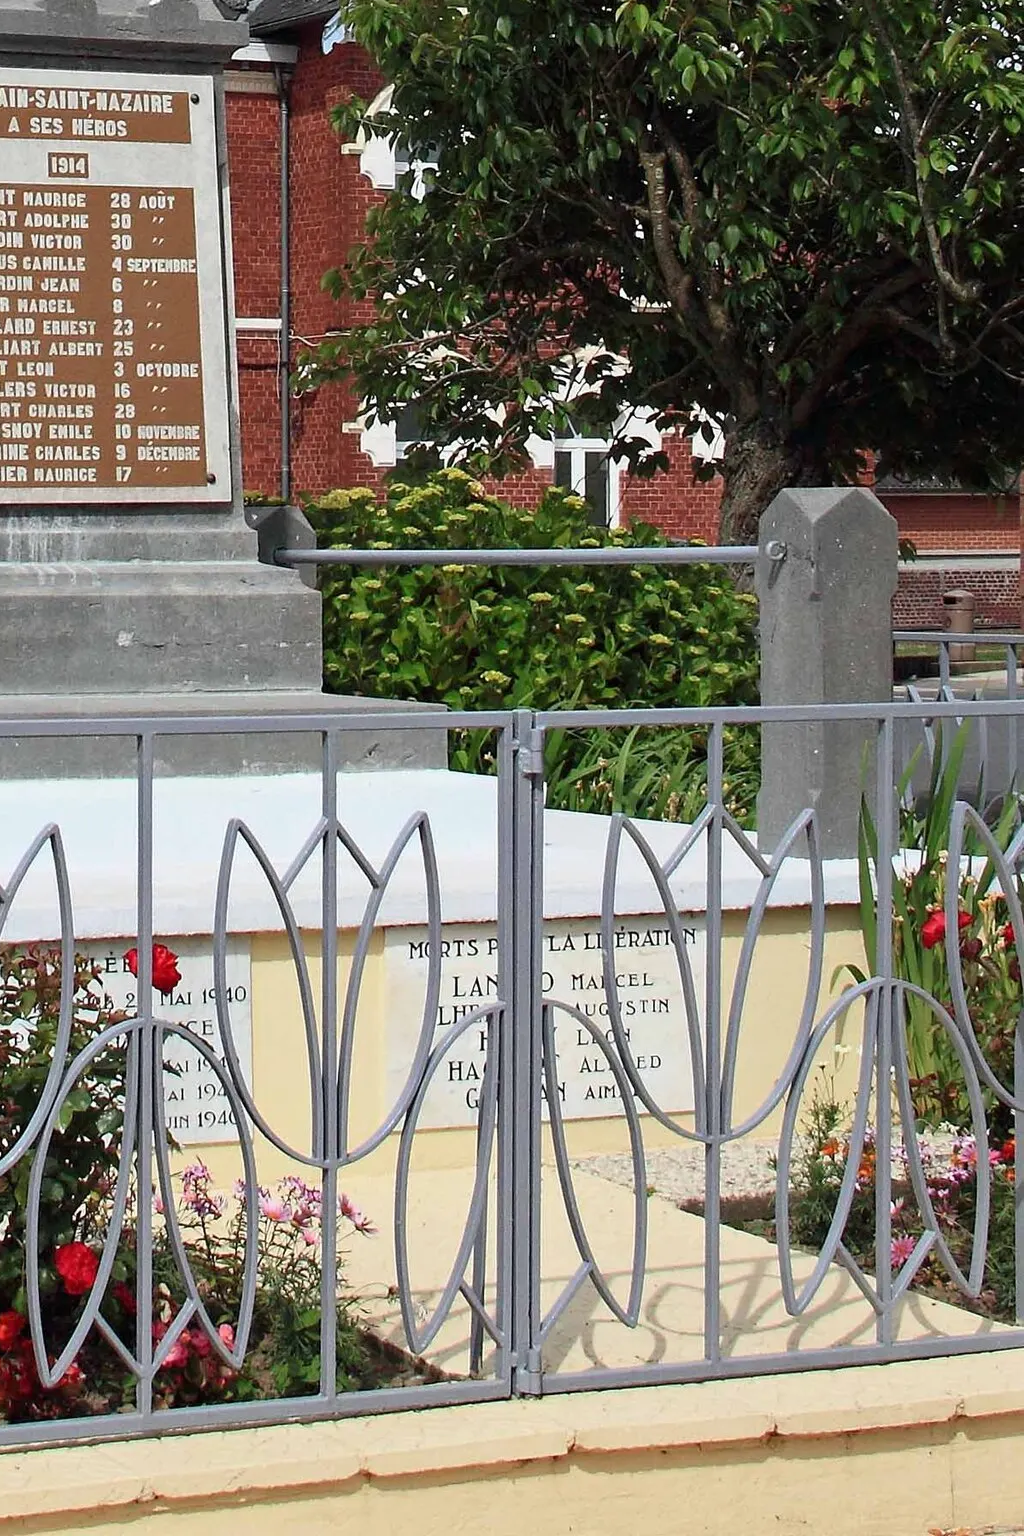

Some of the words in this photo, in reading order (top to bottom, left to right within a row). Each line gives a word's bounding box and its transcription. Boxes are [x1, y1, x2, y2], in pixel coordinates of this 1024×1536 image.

[8, 117, 20, 132] A
[30, 118, 62, 134] SES
[72, 114, 128, 136] HÉROS
[51, 157, 86, 174] 1914
[24, 192, 86, 208] MAURICE
[110, 193, 130, 208] 28
[138, 191, 174, 210] AOÛT
[24, 214, 88, 229] ADOLPHE
[112, 214, 131, 229] 30
[31, 234, 82, 249] VICTOR
[112, 234, 132, 250] 30
[23, 256, 86, 271] CAMILLE
[112, 258, 122, 272] 4
[127, 258, 196, 273] SEPTEMBRE
[40, 278, 80, 292] JEAN
[112, 278, 122, 292] 6
[18, 299, 75, 313] MARCEL
[113, 299, 122, 314] 8
[43, 320, 96, 335] ERNEST
[113, 320, 134, 336] 23
[49, 342, 104, 356] ALBERT
[114, 342, 134, 356] 25
[18, 362, 54, 376] LEON
[114, 362, 124, 377] 3
[136, 363, 198, 378] OCTOBRE
[45, 384, 96, 398] VICTOR
[114, 383, 130, 398] 16
[28, 404, 94, 418] CHARLES
[114, 404, 135, 418] 28
[49, 425, 92, 440] EMILE
[115, 424, 131, 439] 10
[138, 426, 200, 440] NOVEMBRE
[36, 446, 100, 460] CHARLES
[116, 446, 126, 460] 9
[138, 442, 200, 461] DÉCEMBRE
[34, 468, 96, 482] MAURICE
[115, 467, 132, 482] 17
[548, 934, 576, 952] LA
[584, 926, 696, 950] LIÉRATIN
[571, 973, 654, 990] MACEL
[574, 998, 670, 1016] AUGSTIN
[580, 1055, 662, 1073] ALED
